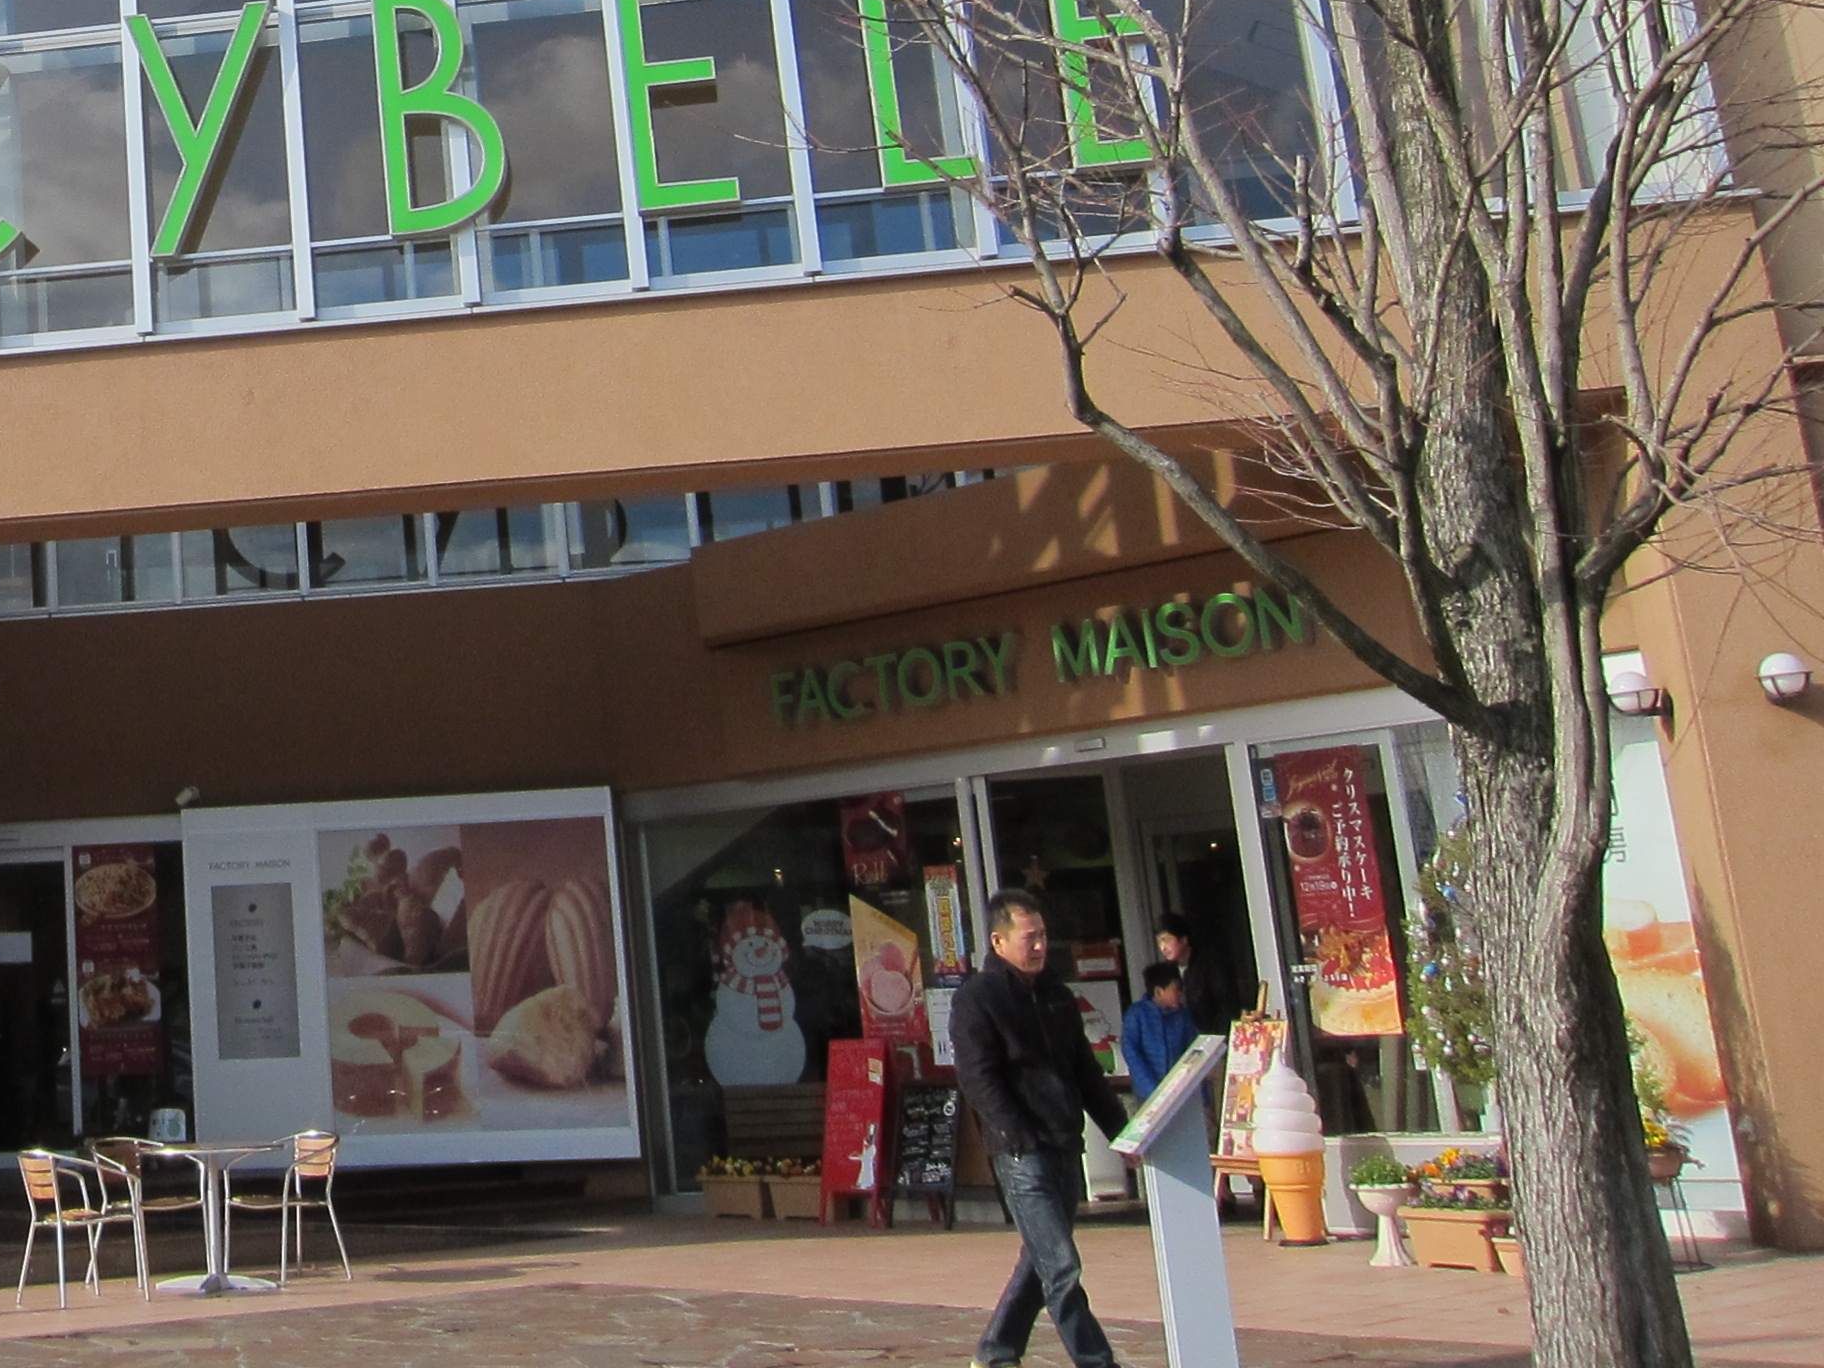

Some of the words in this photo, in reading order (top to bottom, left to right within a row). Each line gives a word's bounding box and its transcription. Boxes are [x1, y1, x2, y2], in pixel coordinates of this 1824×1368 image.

[771, 635, 1016, 724] FACTORY
[1050, 589, 1306, 683] MAISON
[1343, 767, 1374, 901] クリスマスケーキ
